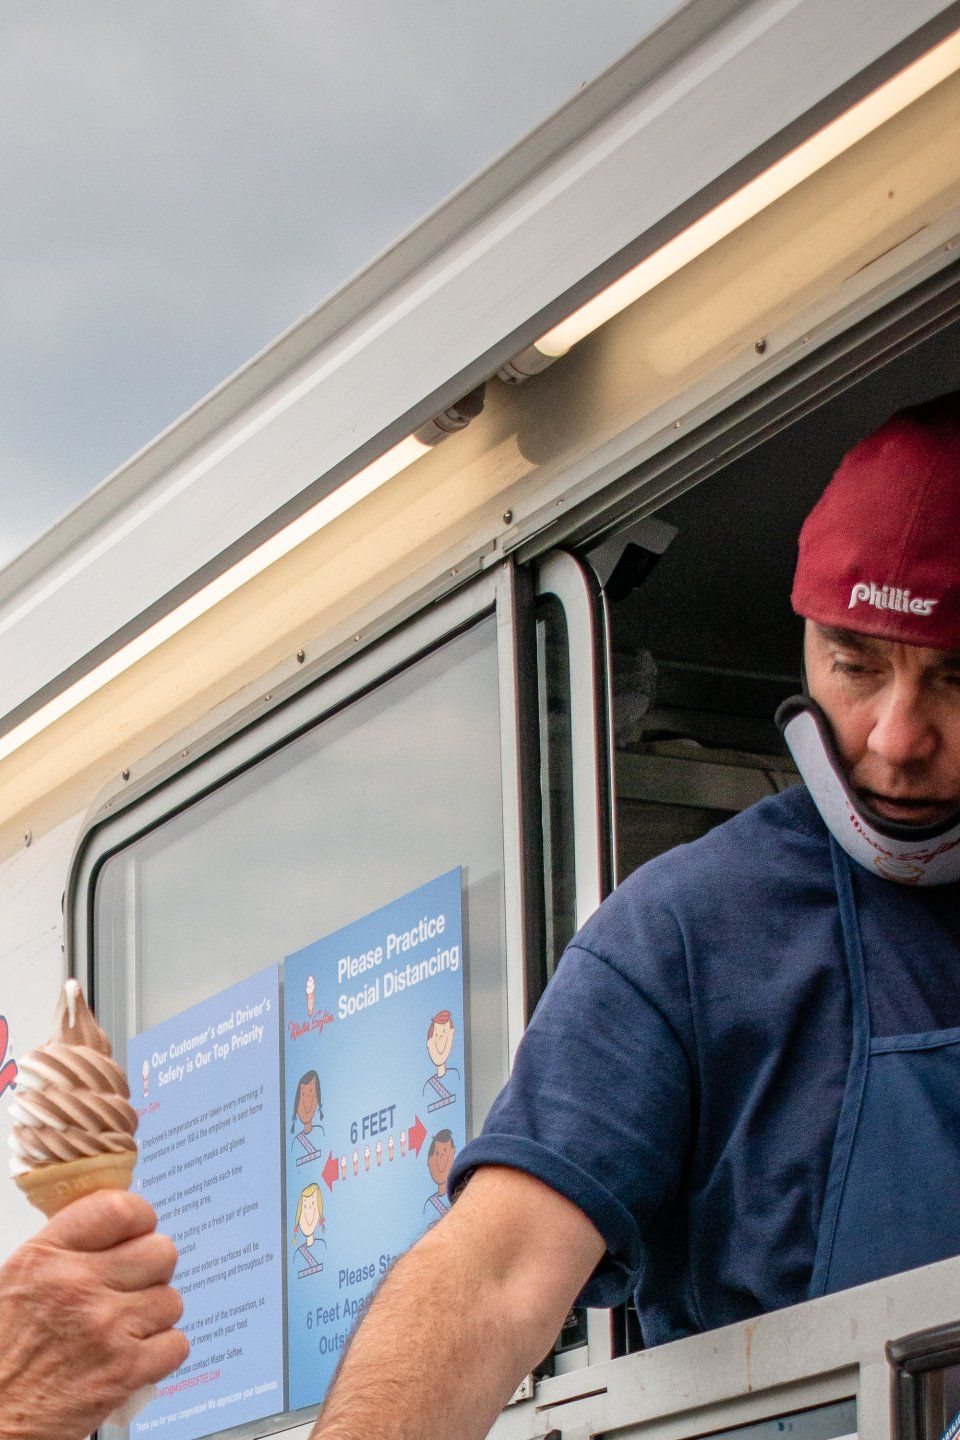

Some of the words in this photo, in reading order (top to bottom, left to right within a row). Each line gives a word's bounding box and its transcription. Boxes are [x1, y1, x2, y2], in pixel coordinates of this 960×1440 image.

[848, 582, 938, 616] Phillies
[338, 946, 383, 984] Please
[386, 914, 445, 959] Practice
[338, 978, 380, 1020] Social
[383, 944, 459, 999] Distancing
[152, 1051, 168, 1068] Our
[169, 1025, 215, 1059] Customer's
[217, 1012, 234, 1036] and
[158, 1065, 184, 1087] Safety
[186, 1057, 193, 1073] is
[195, 1051, 211, 1068] Our
[213, 1043, 229, 1059] Top
[231, 1024, 264, 1051] Priority
[350, 1121, 358, 1145] 6
[362, 1104, 396, 1140] FEET
[338, 1263, 375, 1289] Please
[306, 1311, 313, 1329] 6
[316, 1302, 340, 1327] Feet
